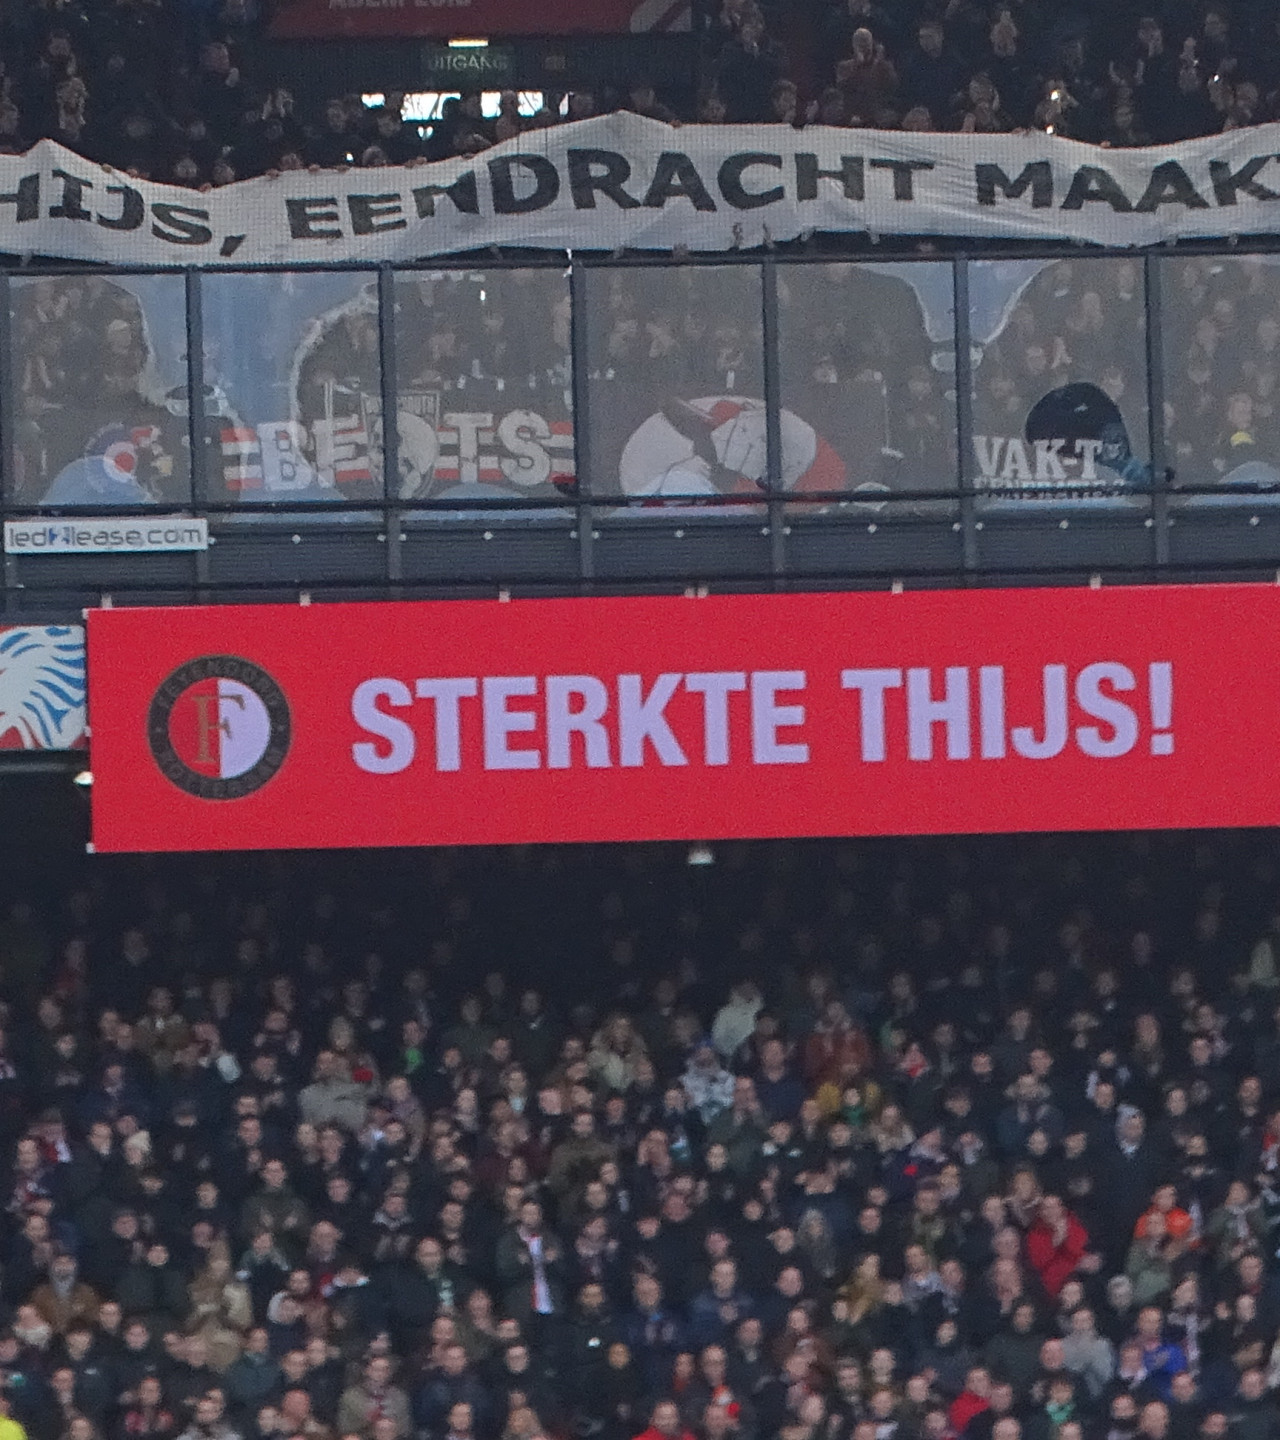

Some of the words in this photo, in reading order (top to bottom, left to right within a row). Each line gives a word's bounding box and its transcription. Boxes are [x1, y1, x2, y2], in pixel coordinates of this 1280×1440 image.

[285, 148, 934, 240] EENDRACHT
[972, 435, 1104, 480] VAK-T
[350, 670, 810, 774] STERKTE
[840, 661, 1175, 763] THIJS!
